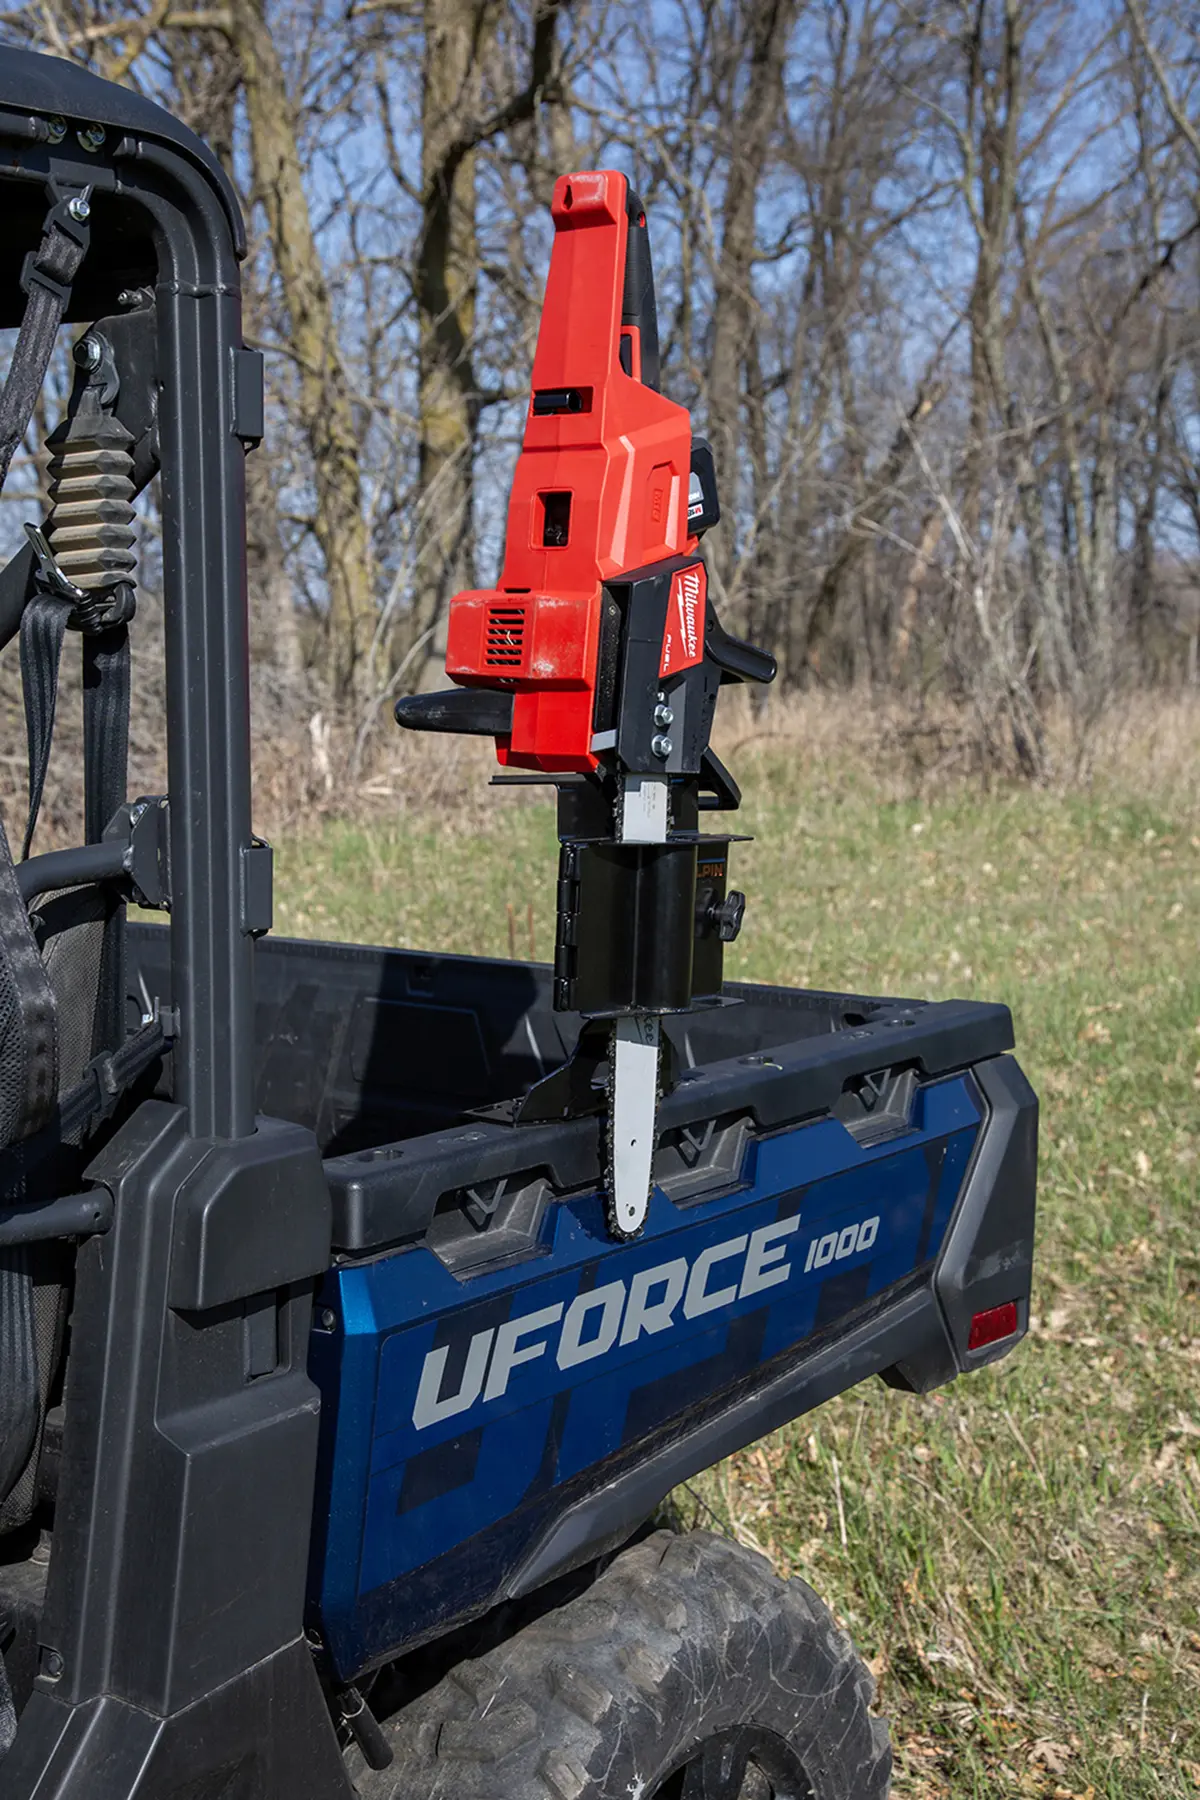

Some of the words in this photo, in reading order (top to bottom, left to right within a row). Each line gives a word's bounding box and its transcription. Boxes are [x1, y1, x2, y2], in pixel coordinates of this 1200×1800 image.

[663, 634, 672, 672] FUEL
[684, 572, 700, 658] Milwaukee
[412, 1214, 801, 1430] UFORCE
[804, 1216, 880, 1273] 1000
